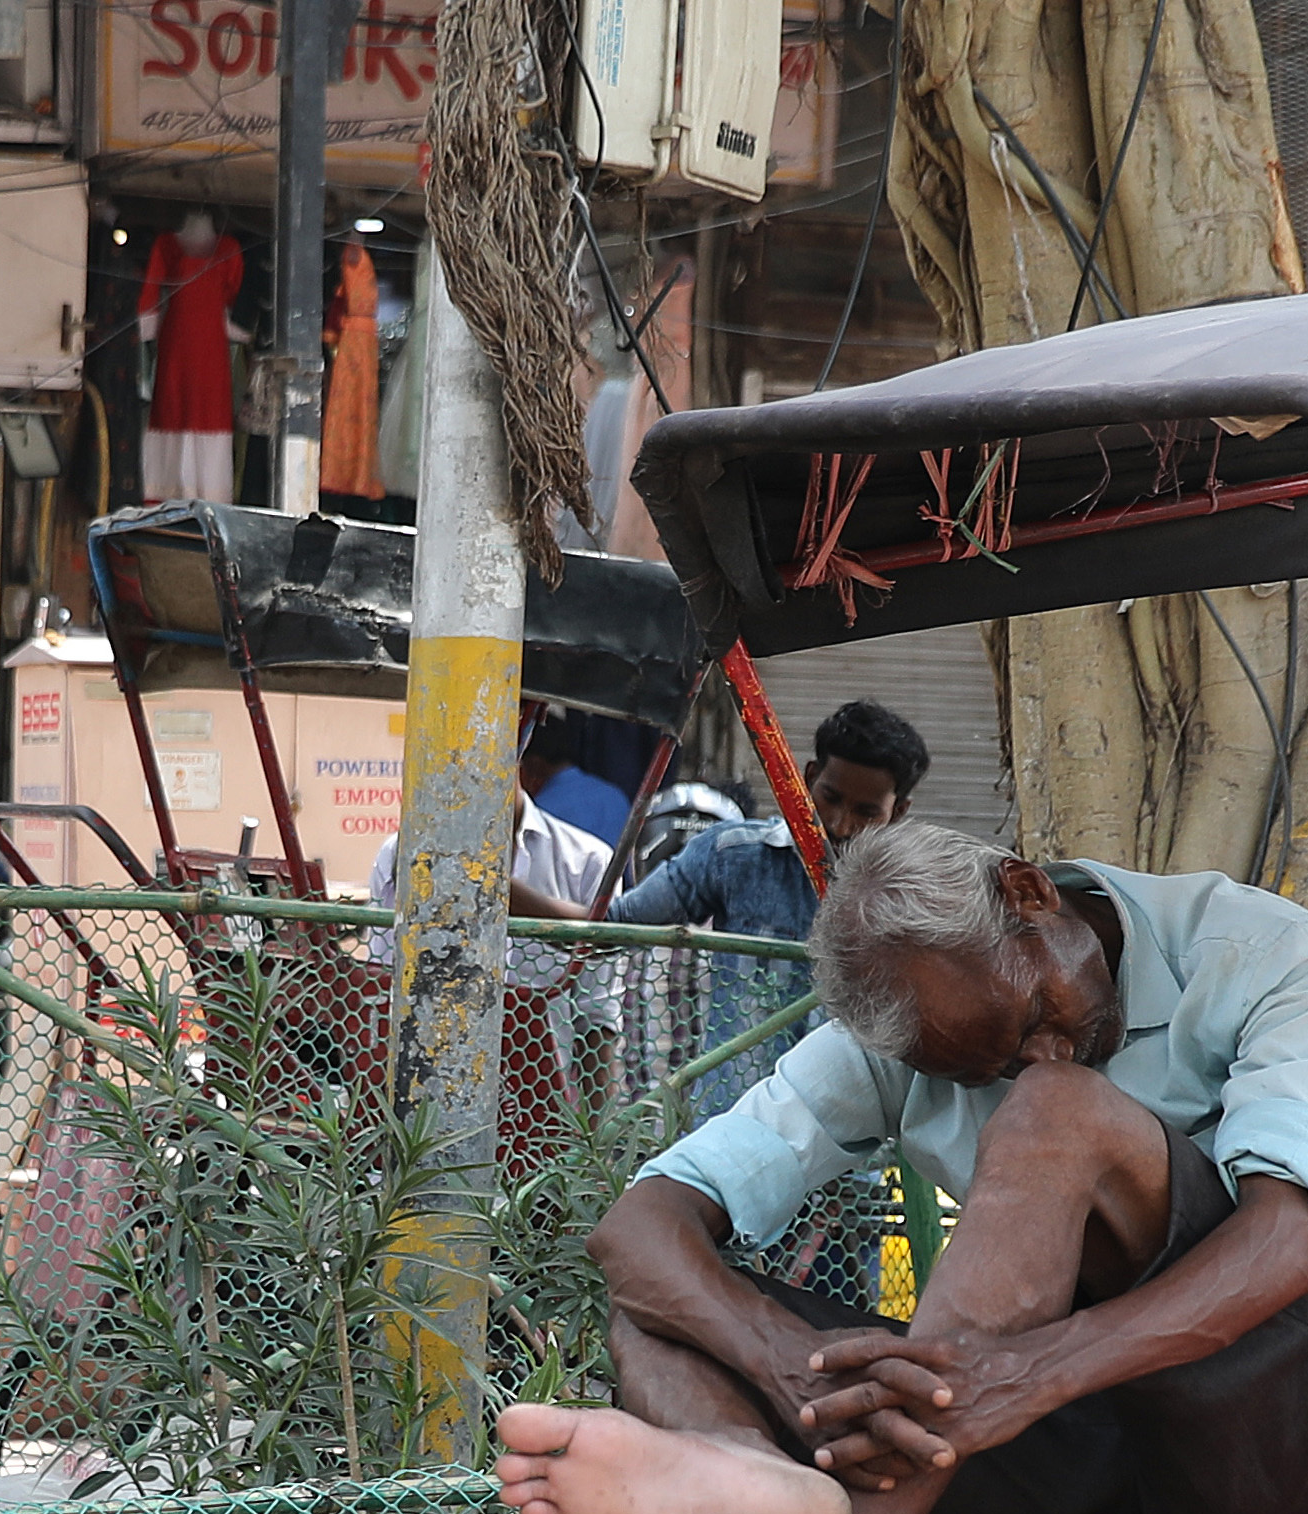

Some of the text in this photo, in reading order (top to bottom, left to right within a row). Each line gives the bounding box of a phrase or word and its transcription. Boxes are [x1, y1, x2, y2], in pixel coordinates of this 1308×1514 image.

[716, 120, 757, 159] Sintex
[22, 692, 61, 732] BSES
[316, 760, 403, 777] POWERI
[341, 817, 400, 835] CONS
